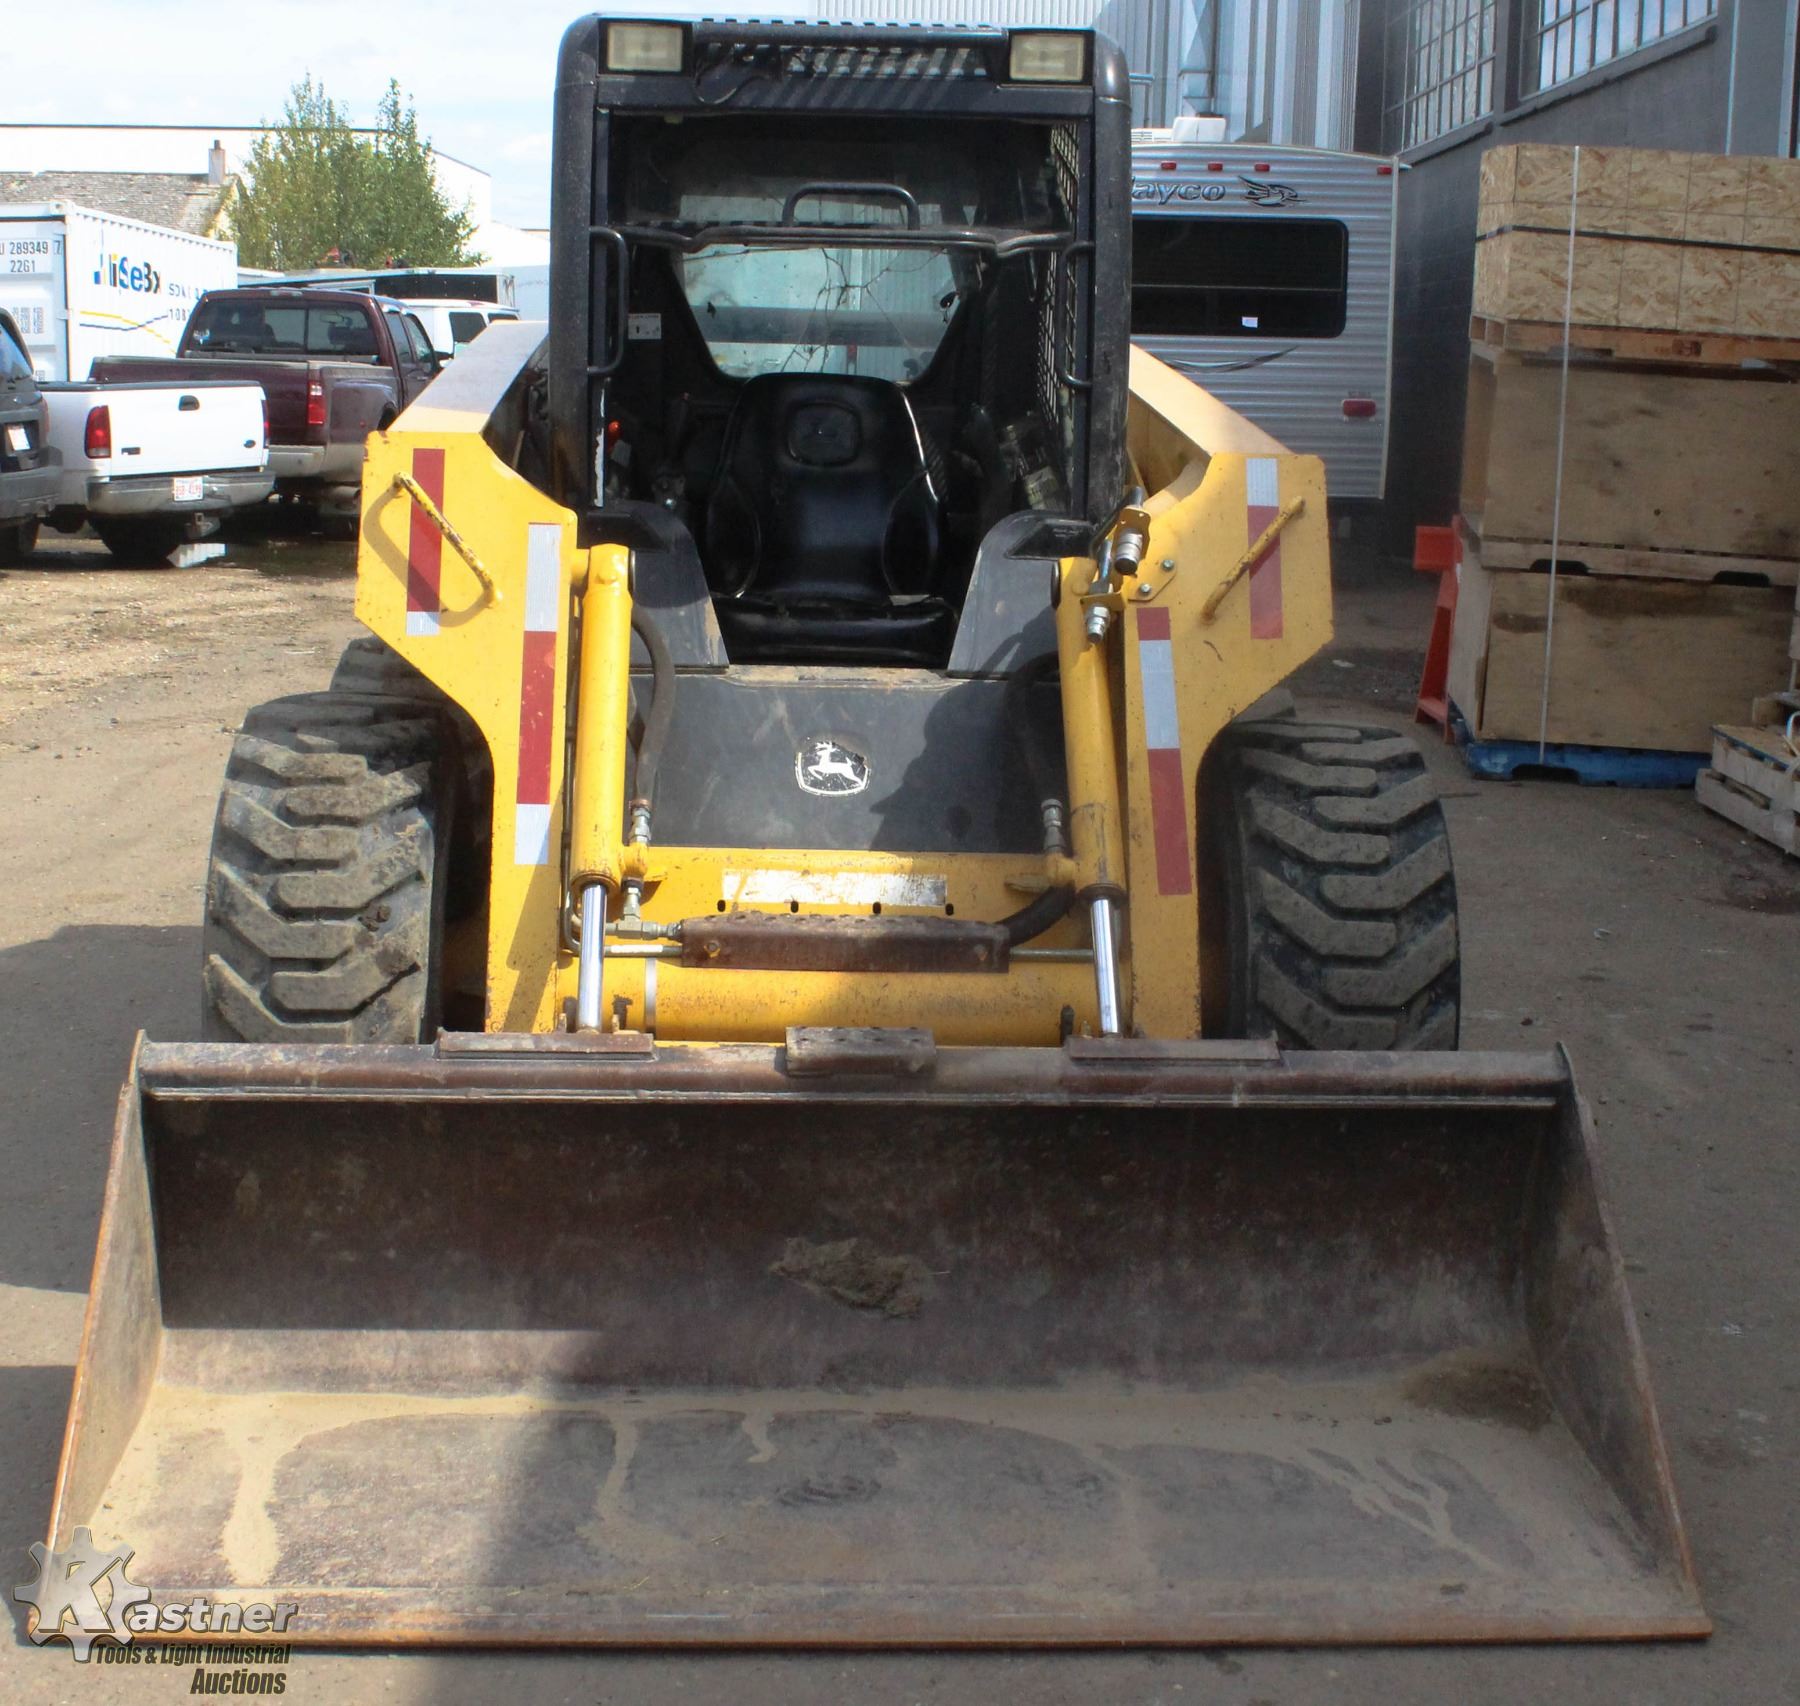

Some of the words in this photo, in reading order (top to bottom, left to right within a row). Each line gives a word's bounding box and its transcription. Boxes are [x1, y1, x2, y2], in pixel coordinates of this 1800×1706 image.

[1131, 176, 1226, 206] ayco
[9, 241, 49, 255] 289349
[10, 259, 36, 273] 2261
